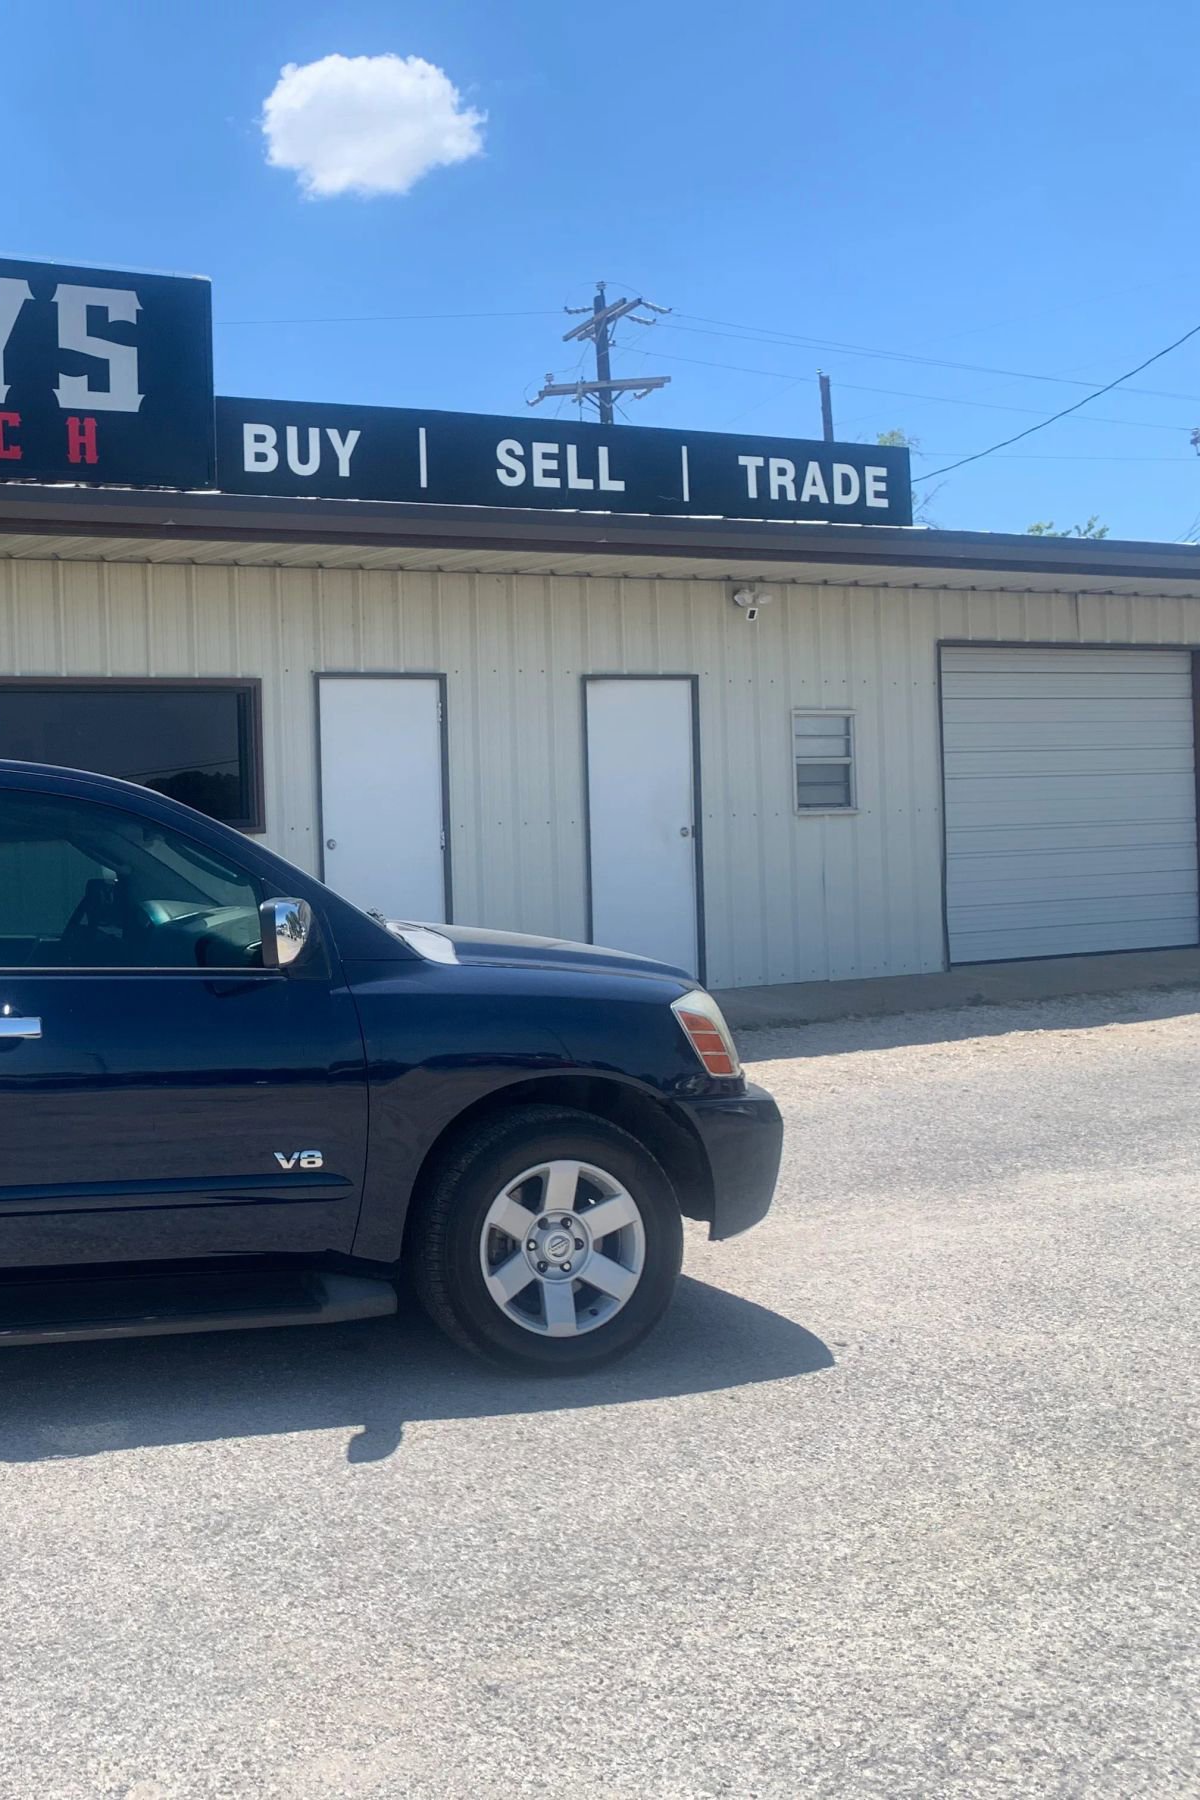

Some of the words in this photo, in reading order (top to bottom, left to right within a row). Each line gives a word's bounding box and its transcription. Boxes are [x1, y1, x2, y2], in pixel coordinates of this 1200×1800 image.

[242, 423, 361, 476] BUY
[496, 439, 625, 491] SELL
[738, 455, 889, 508] TRADE
[273, 1150, 323, 1169] V8
